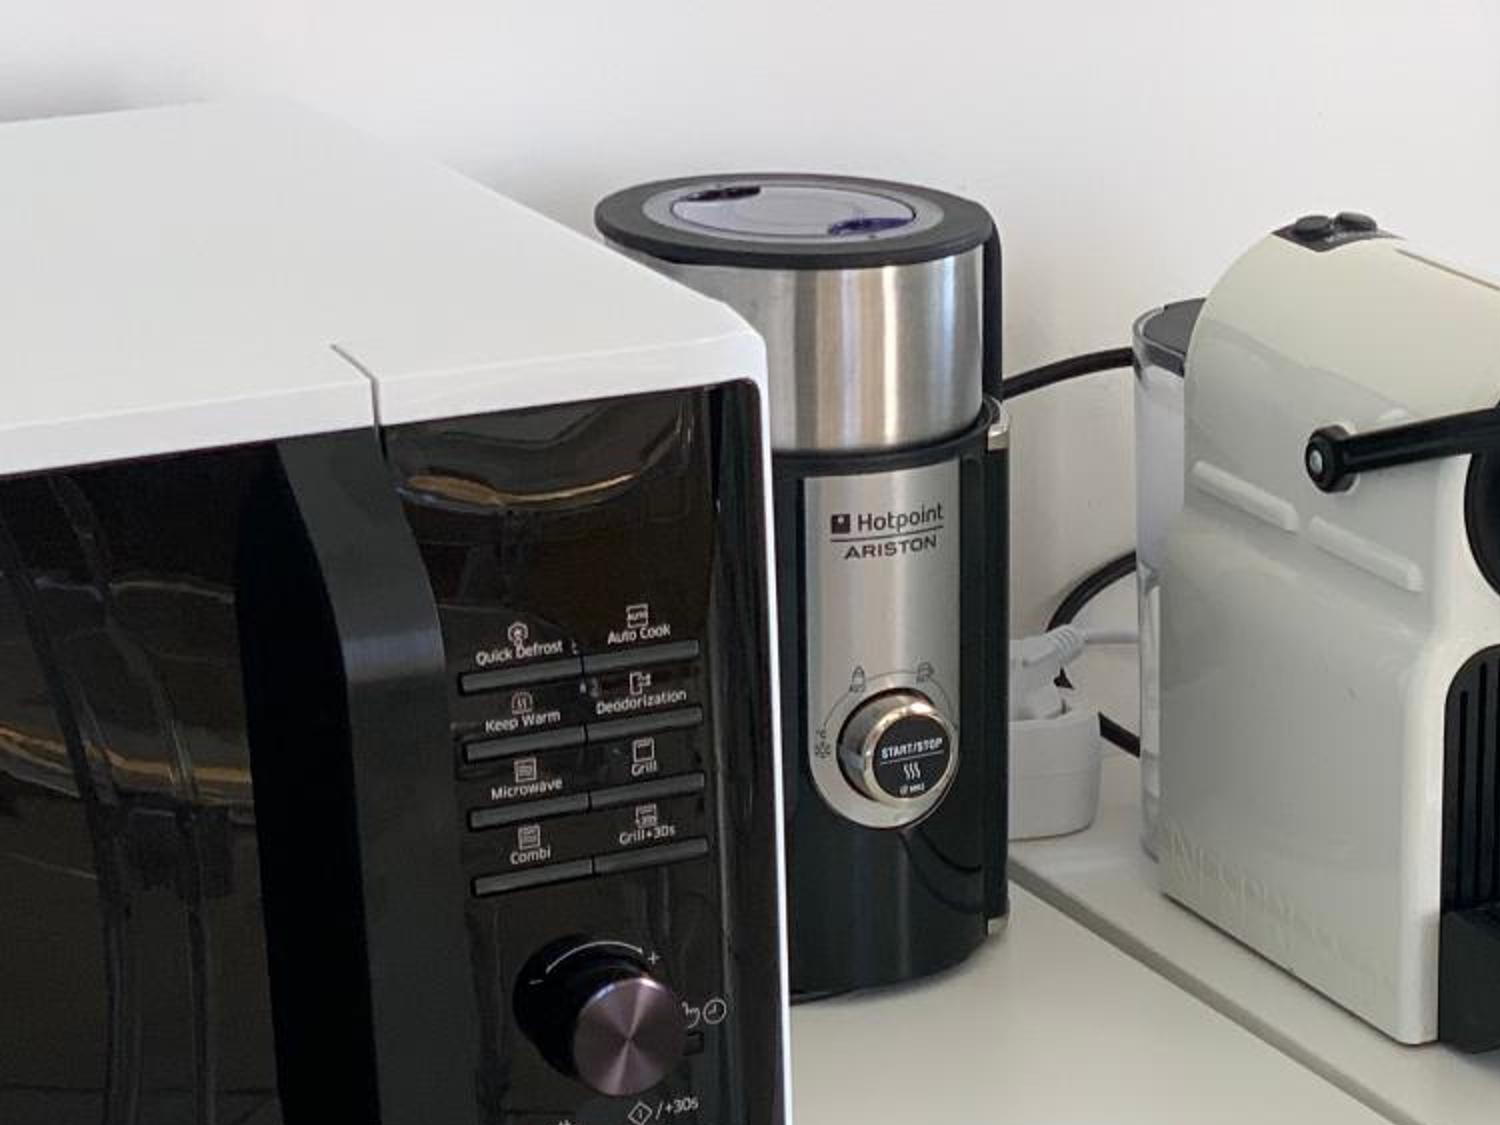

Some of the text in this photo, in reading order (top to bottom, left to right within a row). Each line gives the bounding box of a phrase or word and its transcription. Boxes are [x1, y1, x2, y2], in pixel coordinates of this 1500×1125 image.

[858, 502, 944, 532] Hotpoint
[844, 534, 937, 560] ARISTON
[607, 624, 671, 645] Auto Cook
[475, 640, 563, 666] Quick Defrost
[595, 689, 687, 715] Deodorization
[485, 709, 561, 733] Keep Warm
[881, 737, 943, 759] START/STOP
[631, 760, 658, 777] Grill
[491, 778, 563, 801] Microwave
[510, 846, 552, 865] Combi
